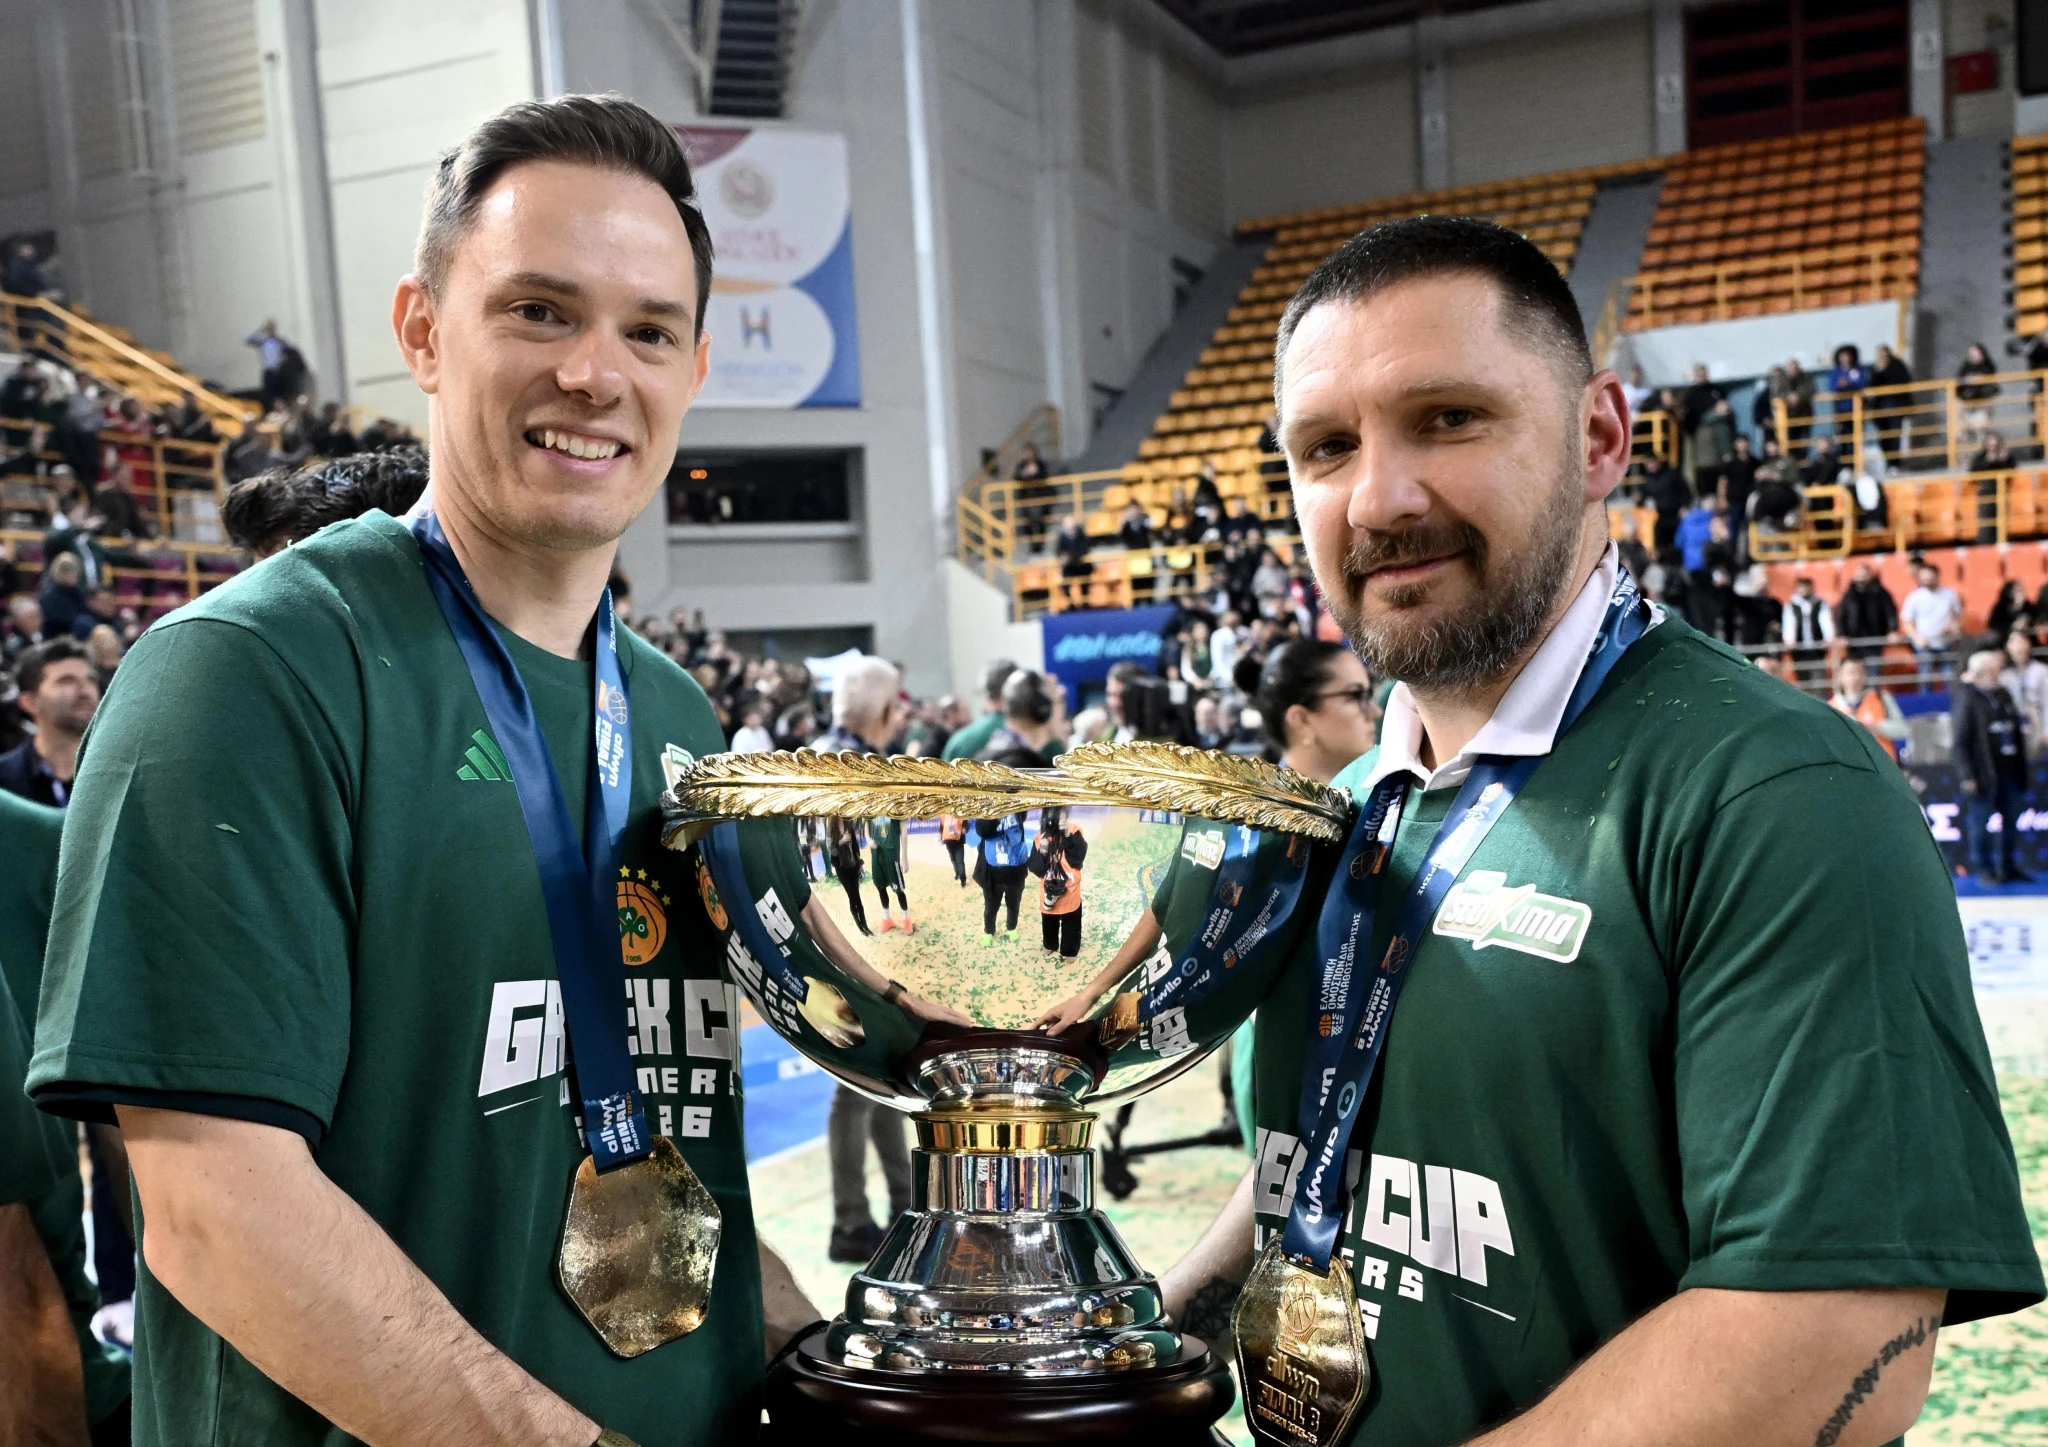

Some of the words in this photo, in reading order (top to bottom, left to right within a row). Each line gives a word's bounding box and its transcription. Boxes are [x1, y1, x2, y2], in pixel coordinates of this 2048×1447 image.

[608, 733, 624, 788] allwyn
[1366, 789, 1391, 842] allwyn
[1319, 958, 1337, 1011] ΕΛΛΗΝΙΚΗ
[1327, 942, 1349, 1010] ΟΜΟΣΠΟΝΔΙΑ
[1337, 912, 1361, 1009] ΚΑΛΑΘΟΣΦΑΙΡΙΣΗΣ
[1362, 978, 1386, 1039] FINAL
[1366, 985, 1391, 1049] allwyn
[616, 1099, 634, 1154] FINAL
[1306, 1126, 1338, 1223] allwyn
[1362, 1153, 1515, 1287] CUP
[1258, 1380, 1305, 1426] FINAL
[1266, 1354, 1319, 1399] allwyn
